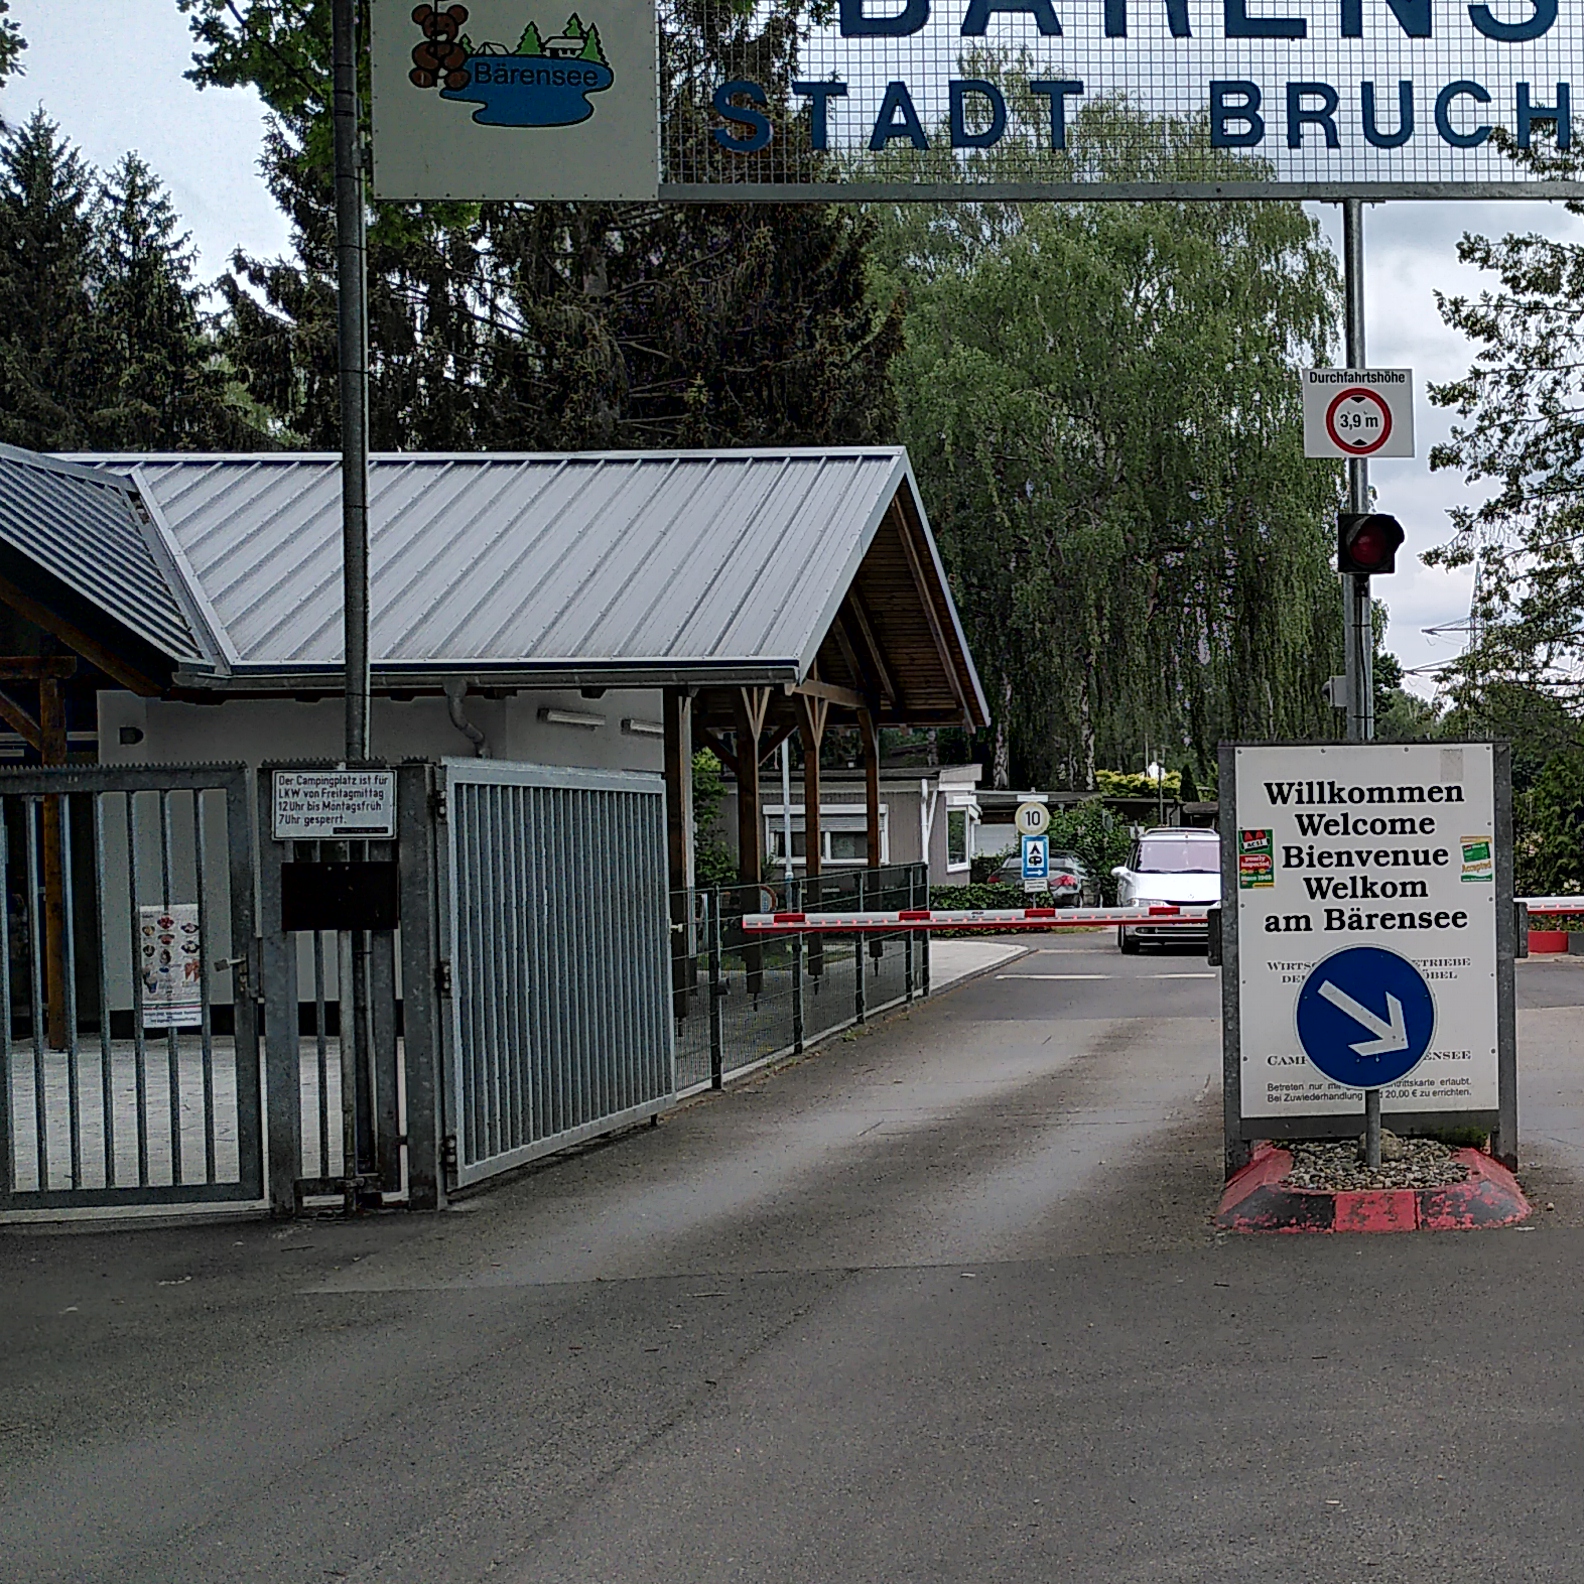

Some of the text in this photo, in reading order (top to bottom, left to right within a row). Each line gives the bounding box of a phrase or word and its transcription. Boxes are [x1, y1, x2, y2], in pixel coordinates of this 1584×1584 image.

[474, 62, 598, 86] Bärensee
[713, 79, 1084, 152] STADT
[1309, 371, 1405, 384] Durchfahrtshöhe
[1340, 413, 1378, 430] 3,9 m
[279, 774, 389, 788] Der Campingplatz ist für
[279, 788, 384, 800] LKW von Freitagmittag
[1263, 781, 1465, 805] Willkommen
[307, 801, 320, 811] bis
[304, 815, 347, 827] gesperrt.
[1025, 810, 1041, 826] 10
[1295, 812, 1436, 836] Welcome
[1282, 846, 1449, 869] Bienvenue
[1303, 876, 1428, 900] Welkom
[1264, 907, 1468, 932] am Bärensee
[1267, 1082, 1304, 1092] Betreten
[1385, 1089, 1410, 1099] 20,00
[1412, 1088, 1418, 1097] €
[1267, 1091, 1363, 1103] Bei Zuwiederhandlung
